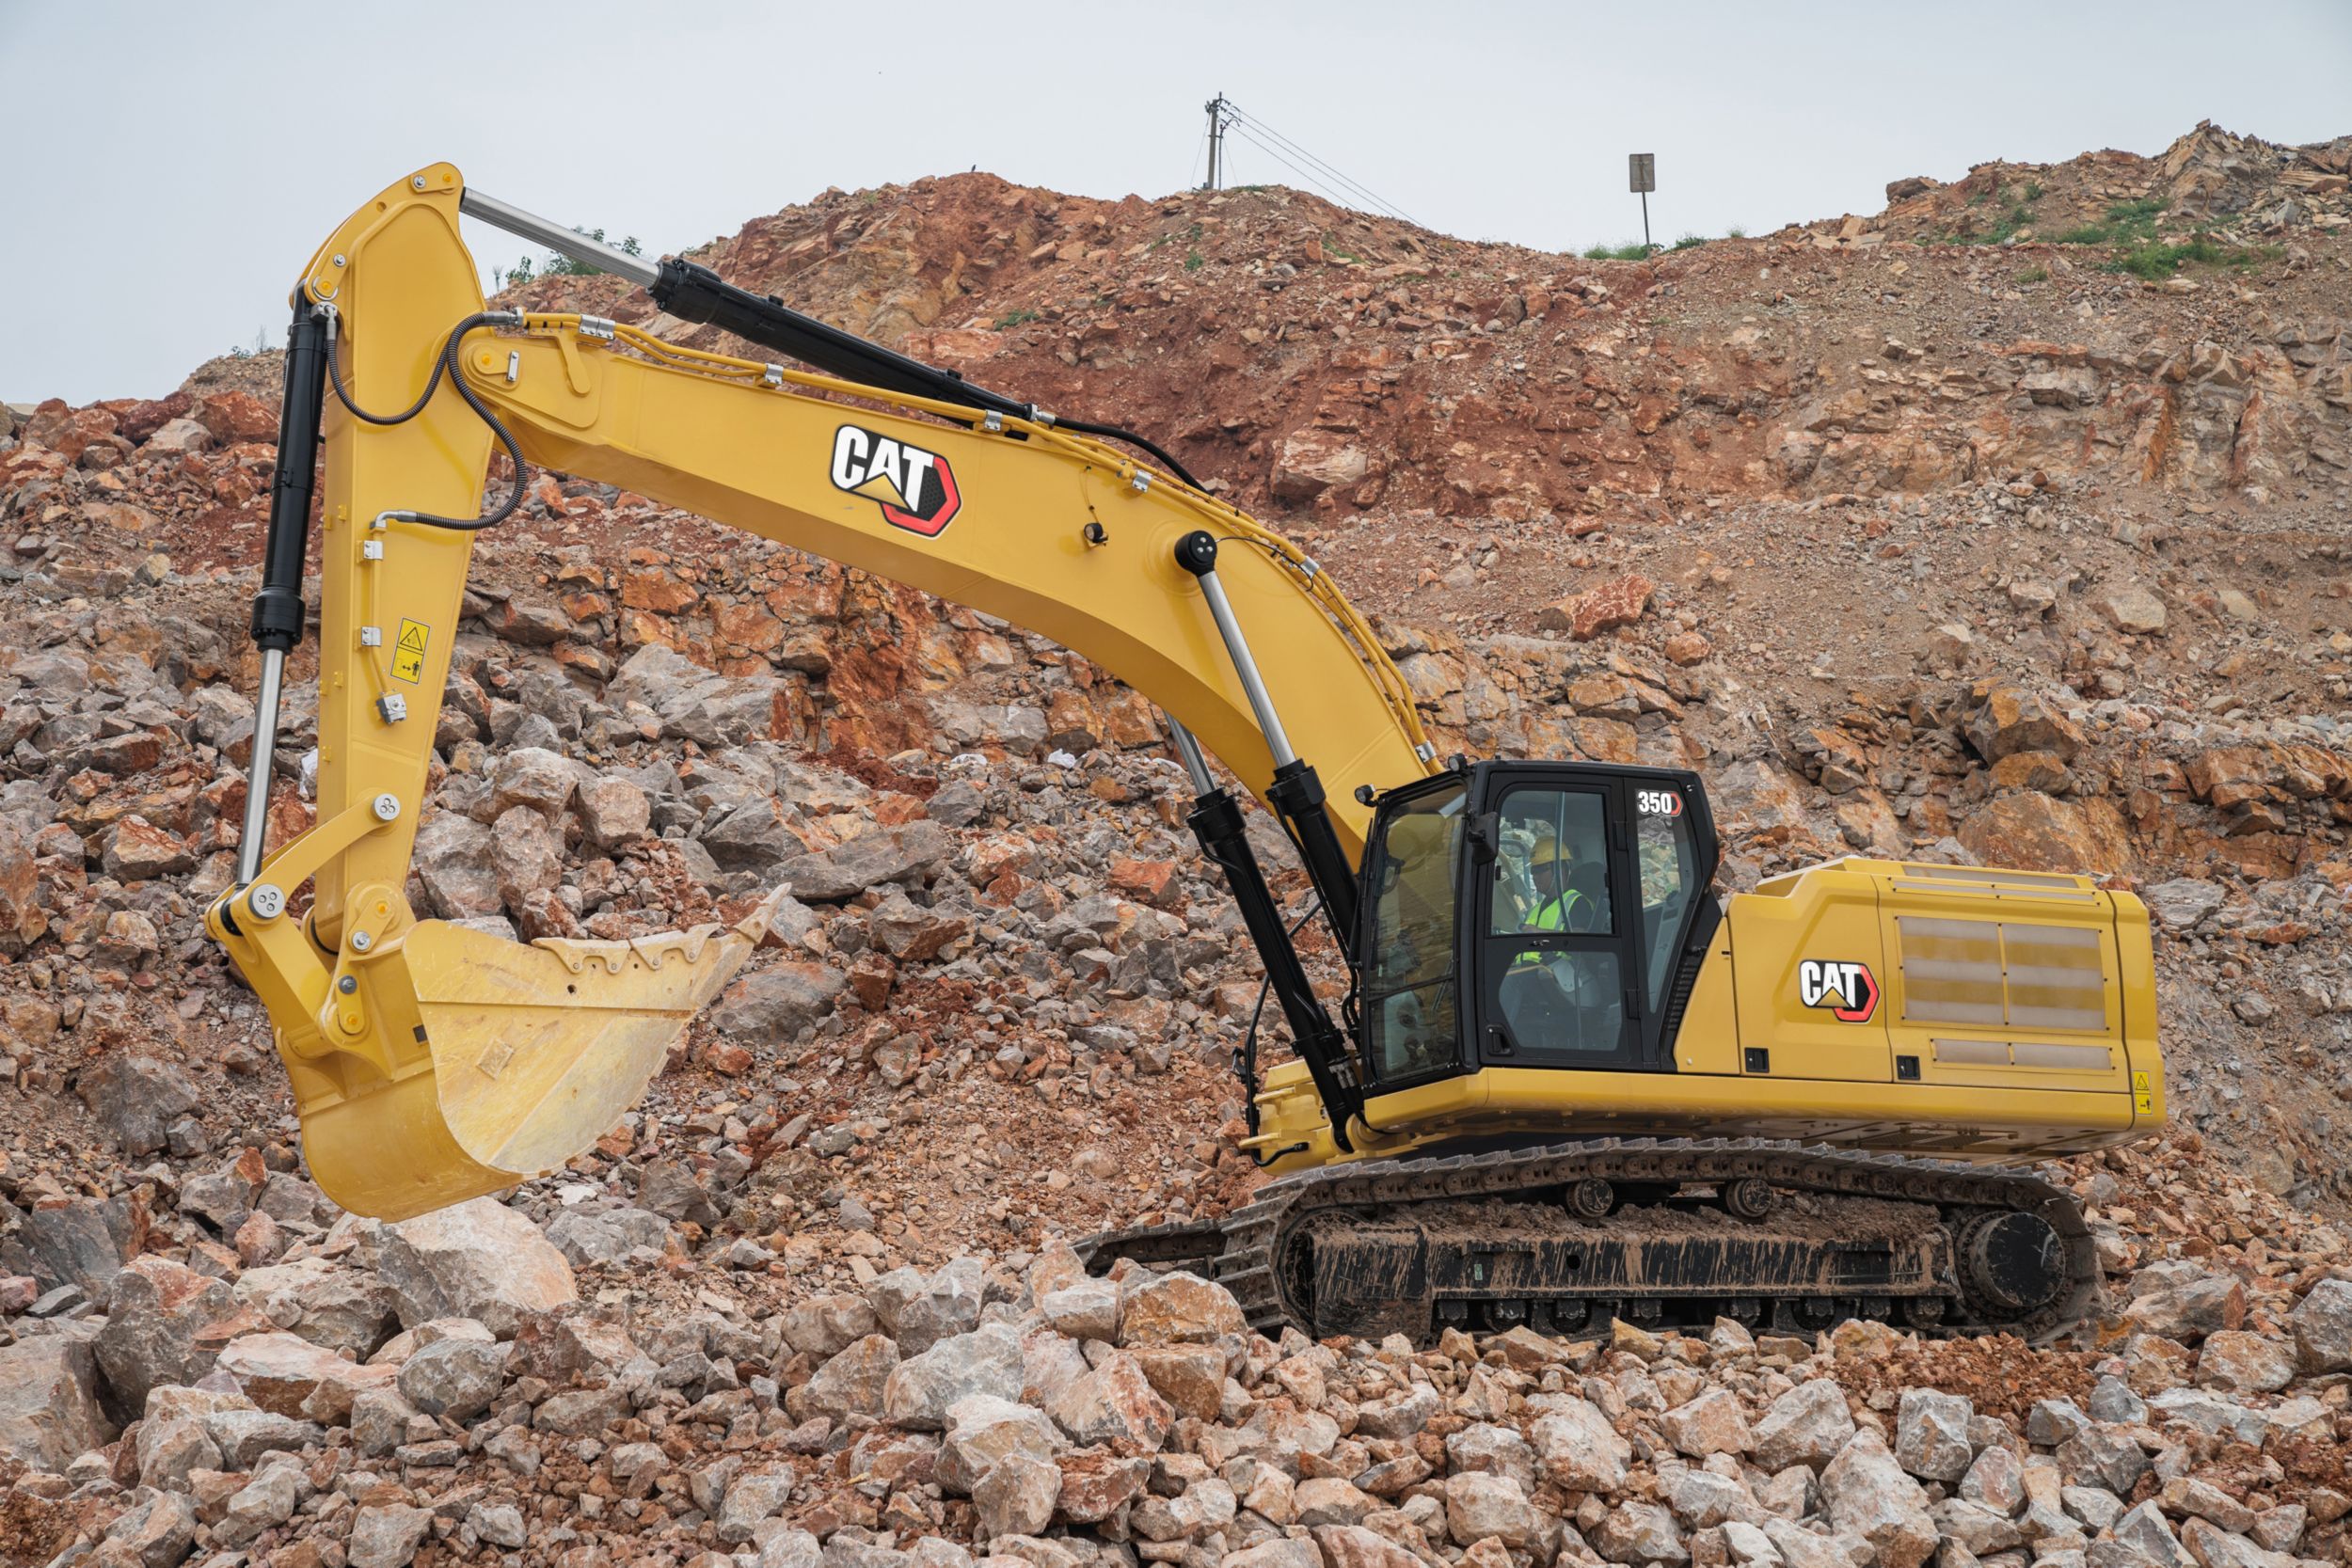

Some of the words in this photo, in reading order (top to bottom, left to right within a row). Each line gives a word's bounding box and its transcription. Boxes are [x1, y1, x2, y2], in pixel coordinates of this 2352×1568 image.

[832, 425, 934, 513] CAT
[1638, 791, 1672, 815] 350
[1801, 960, 1859, 1008] CAT
